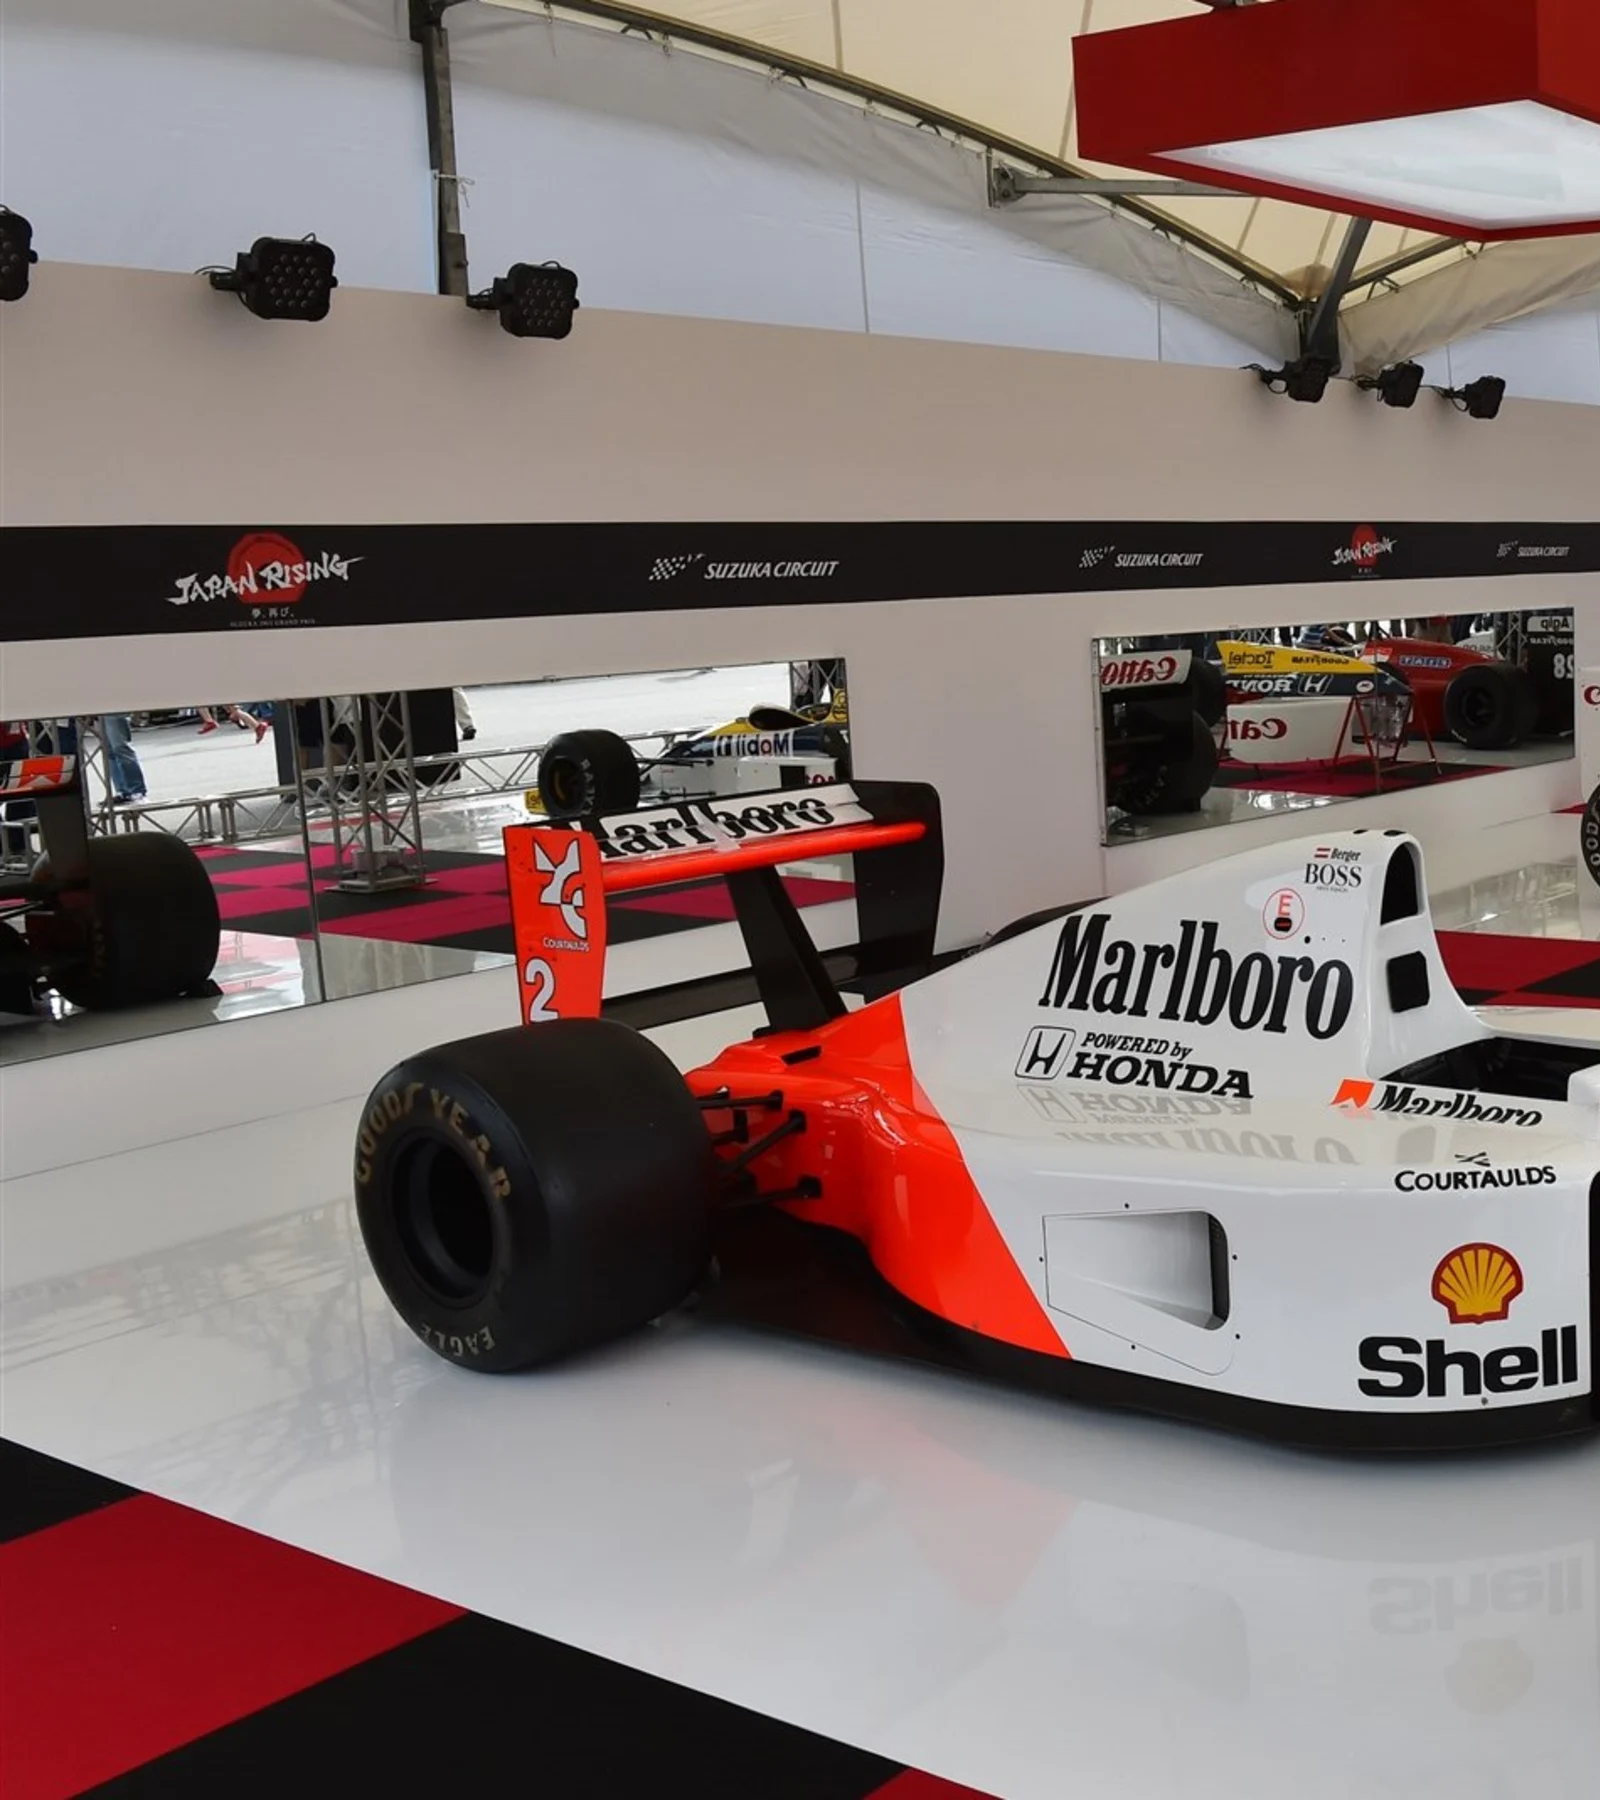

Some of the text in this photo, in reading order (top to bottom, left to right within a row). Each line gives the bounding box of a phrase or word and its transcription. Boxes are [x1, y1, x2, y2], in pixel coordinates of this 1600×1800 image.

[704, 560, 840, 579] SUZUKA CIRCUIT
[1114, 553, 1204, 568] SUZUKA CIRCUIT
[165, 551, 367, 605] JAPAN RISING
[1331, 847, 1362, 862] Berger
[1305, 863, 1362, 888] BOSS
[1278, 894, 1293, 916] E
[525, 958, 559, 1023] 2
[1038, 913, 1354, 1040] Marlboro
[1081, 1032, 1193, 1061] POWERED by
[1066, 1051, 1254, 1099] HONDA
[1375, 1083, 1544, 1128] Marlboro
[1394, 1164, 1557, 1192] COURTAULDS
[1358, 1324, 1578, 1399] Shell
